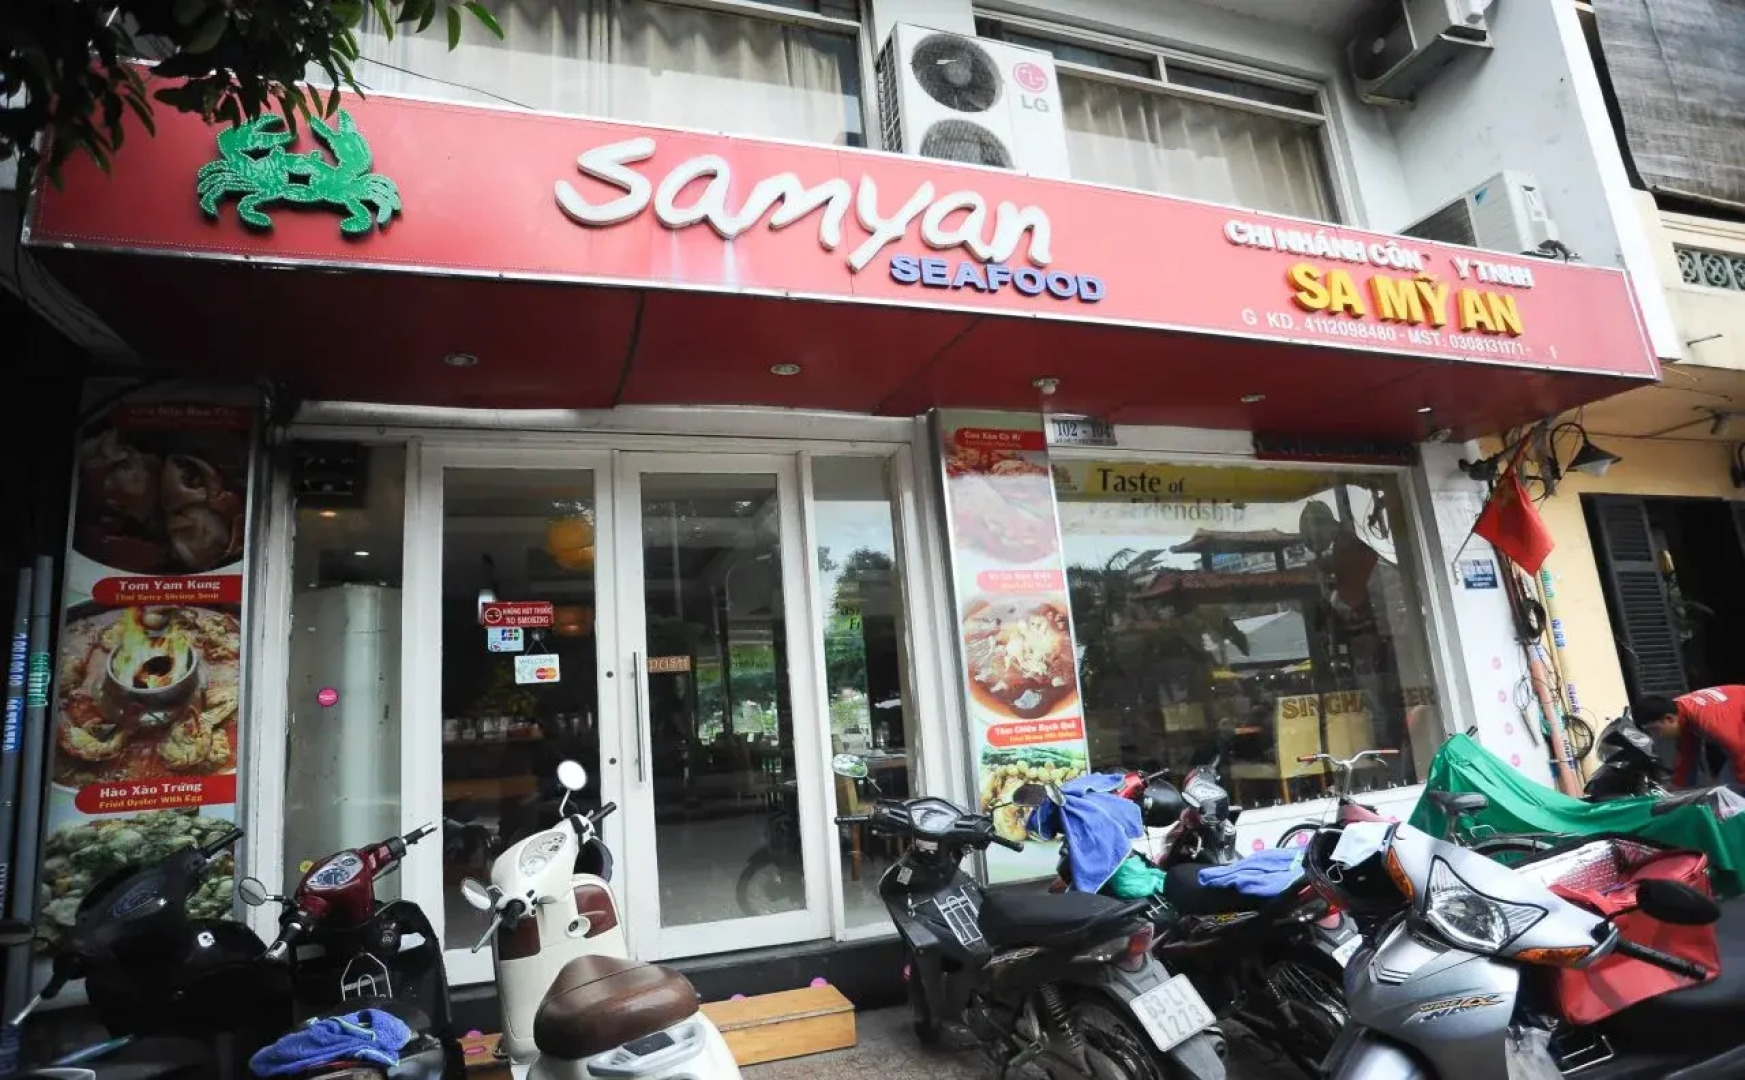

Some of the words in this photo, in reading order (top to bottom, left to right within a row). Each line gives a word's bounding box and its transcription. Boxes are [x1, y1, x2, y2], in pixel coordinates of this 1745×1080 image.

[1021, 93, 1049, 113] LG
[1224, 219, 1275, 249] CHI
[1275, 230, 1368, 263] NHÁNH
[1472, 261, 1534, 288] TNHH
[889, 254, 1106, 302] SEAFOOD
[1289, 263, 1366, 318] SA
[1459, 289, 1523, 337] AN
[1304, 317, 1396, 341] 4112098480
[1057, 422, 1078, 437] 102
[1097, 468, 1161, 493] Taste
[1168, 477, 1185, 494] of
[119, 580, 149, 591] Tom
[153, 580, 183, 590] Yam
[187, 580, 221, 590] Kung
[505, 616, 516, 624] NO
[517, 615, 549, 624] SMOKING
[99, 788, 128, 799] Hào
[132, 785, 158, 796] Xào
[99, 799, 125, 809] Fried
